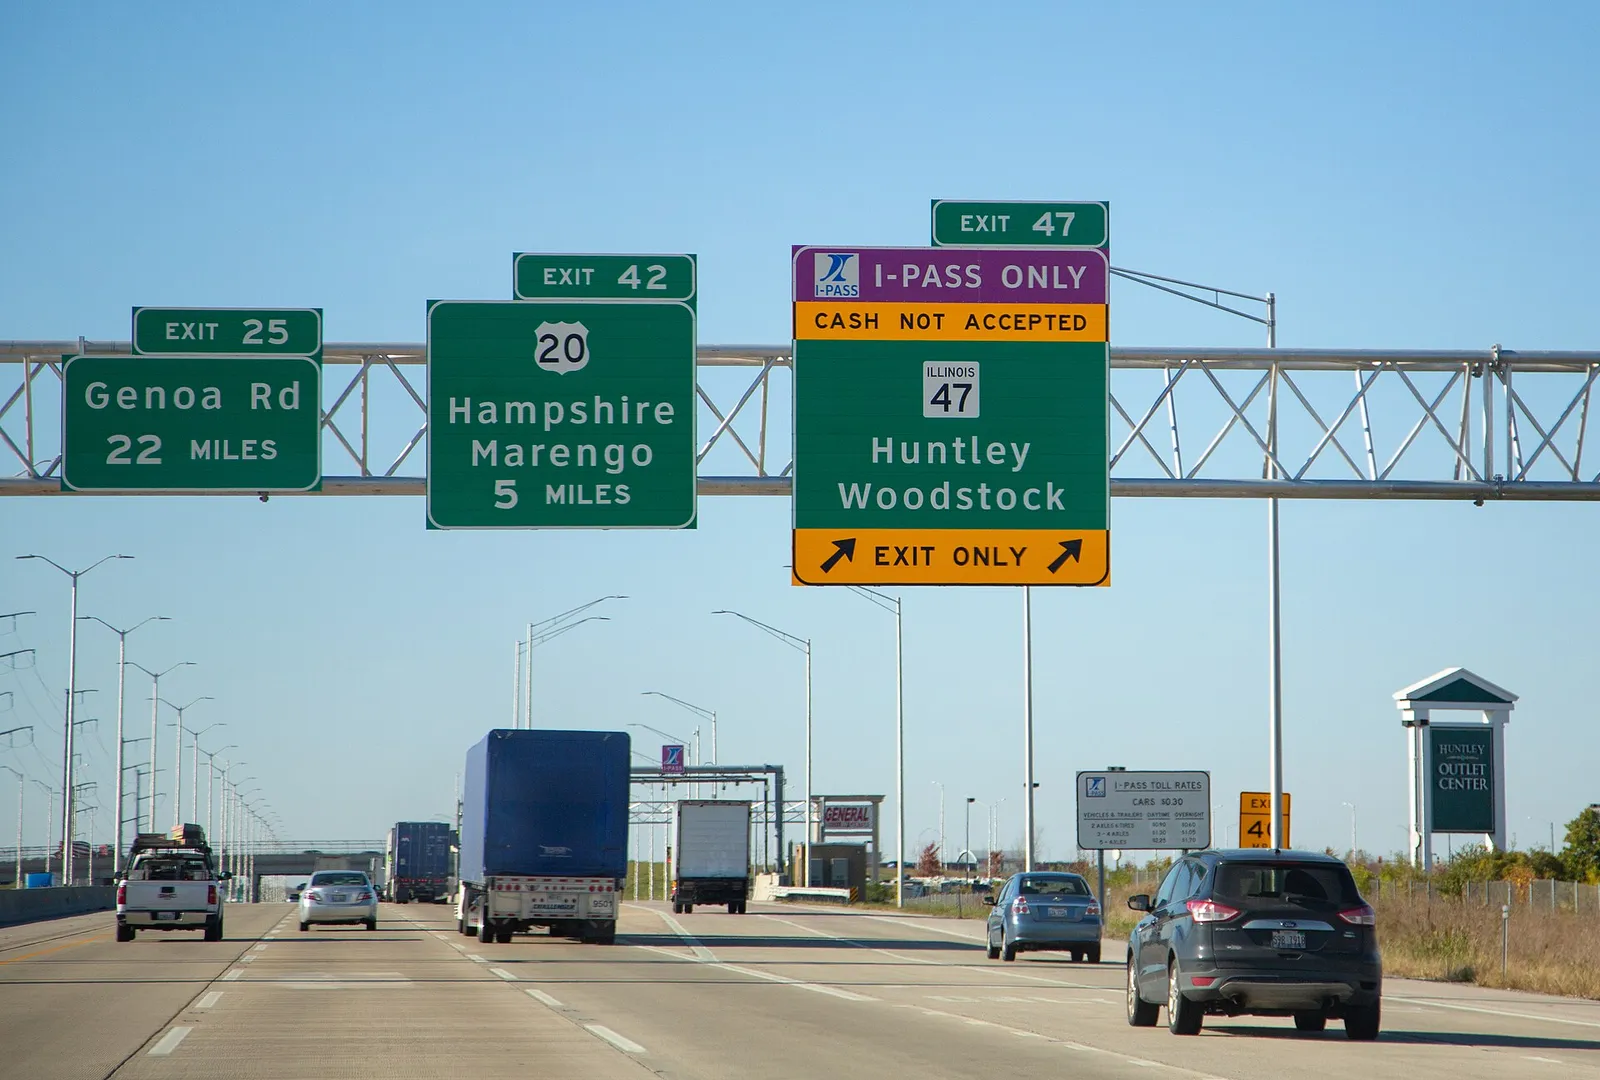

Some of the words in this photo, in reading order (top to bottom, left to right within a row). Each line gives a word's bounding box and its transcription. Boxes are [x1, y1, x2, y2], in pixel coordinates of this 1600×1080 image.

[961, 215, 1010, 231] EXIT
[1032, 212, 1075, 236] 47
[544, 268, 594, 285] EXIT
[618, 265, 666, 289] 42
[876, 264, 981, 288] I-PASS
[1002, 265, 1086, 288] ONLY
[816, 284, 858, 297] I-PASS
[166, 323, 218, 340] EXIT
[243, 319, 288, 344] 25
[815, 313, 878, 329] CASH
[901, 313, 945, 329] NOT
[965, 314, 1086, 330] ACCEPTED
[538, 334, 585, 364] 20
[928, 367, 974, 377] ILLINOIS
[85, 382, 221, 409] Genoa
[251, 381, 299, 409] Rd
[931, 384, 972, 412] 47
[450, 396, 674, 431] Hampshire
[106, 435, 161, 464] 22
[191, 440, 277, 459] MILES
[472, 440, 652, 474] Marengo
[873, 436, 1030, 472] Huntley
[495, 480, 518, 509] 5
[546, 485, 630, 504] MILES
[838, 482, 1065, 510] Woodstock
[876, 547, 935, 566] EXIT
[954, 547, 1027, 566] ONLY
[1439, 744, 1484, 754] HUNTLEY
[1439, 763, 1486, 775] OUTLET
[1439, 778, 1488, 790] CENTER
[825, 807, 869, 821] GENERAL
[1132, 798, 1155, 806] CARS
[1161, 798, 1183, 806] $0.30
[1251, 799, 1270, 808] EXI
